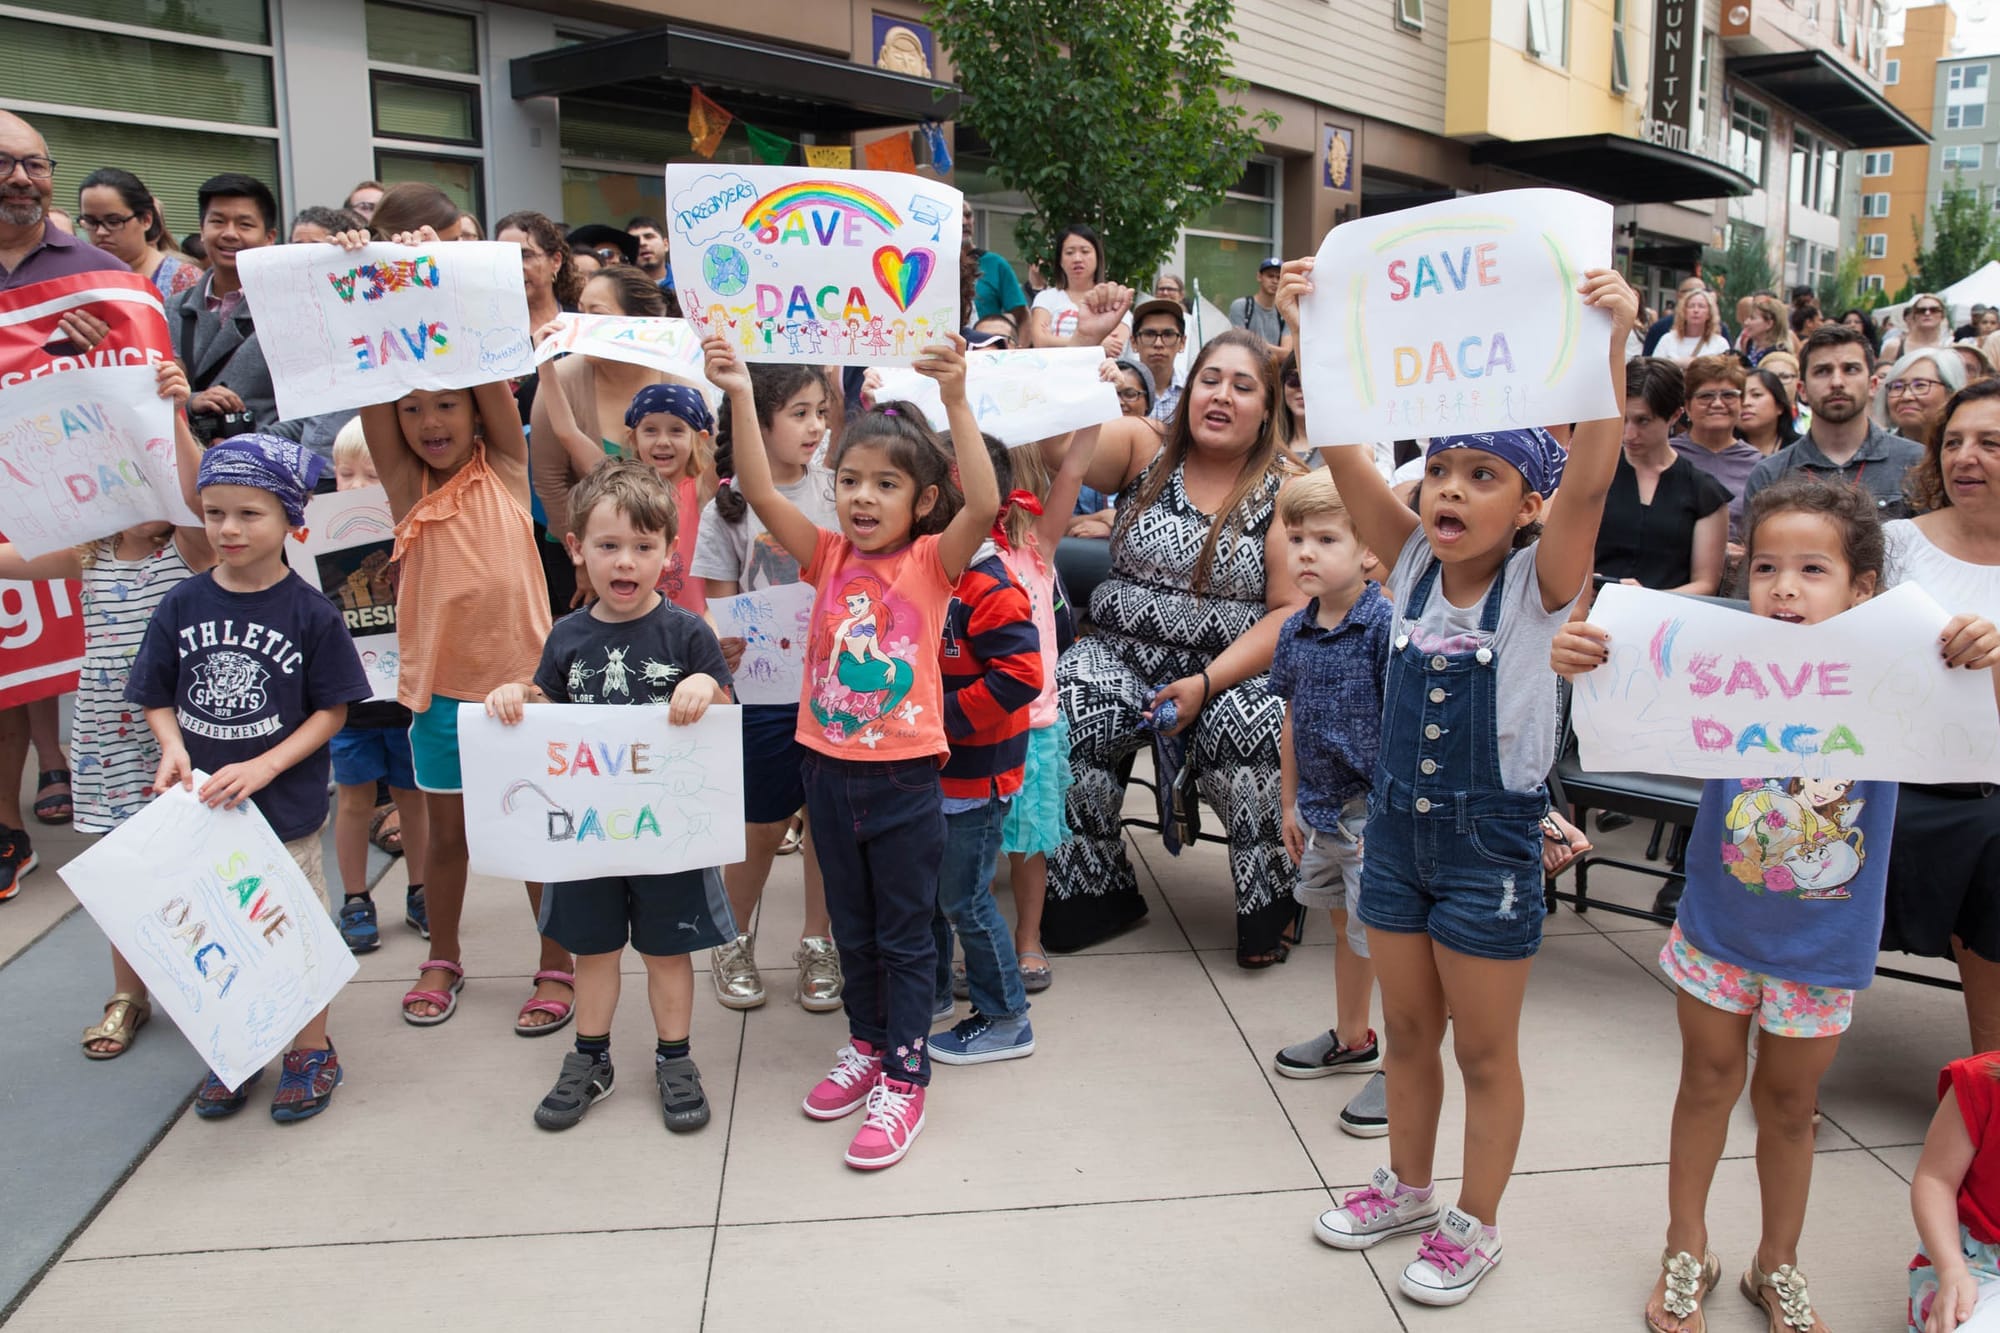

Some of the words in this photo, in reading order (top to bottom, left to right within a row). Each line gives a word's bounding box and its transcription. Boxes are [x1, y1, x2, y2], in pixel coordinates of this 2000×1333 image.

[1662, 0, 1682, 119] UNITY
[679, 184, 751, 230] DREAMERS
[756, 208, 864, 247] SAVE
[1387, 241, 1501, 302] SAVE
[755, 283, 872, 323] DACA
[350, 318, 449, 373] SAVE
[608, 328, 675, 347] ACA
[1392, 331, 1517, 388] DACA
[64, 458, 153, 504] DACA
[195, 688, 260, 709] SPORTS
[1686, 652, 1853, 700] SAVE
[183, 716, 267, 739] DEPARTMENT
[1691, 714, 1865, 758] DACA
[547, 739, 653, 778] SAVE
[547, 803, 662, 843] DACA
[216, 852, 294, 947] SAVE
[155, 896, 239, 999] DACA
